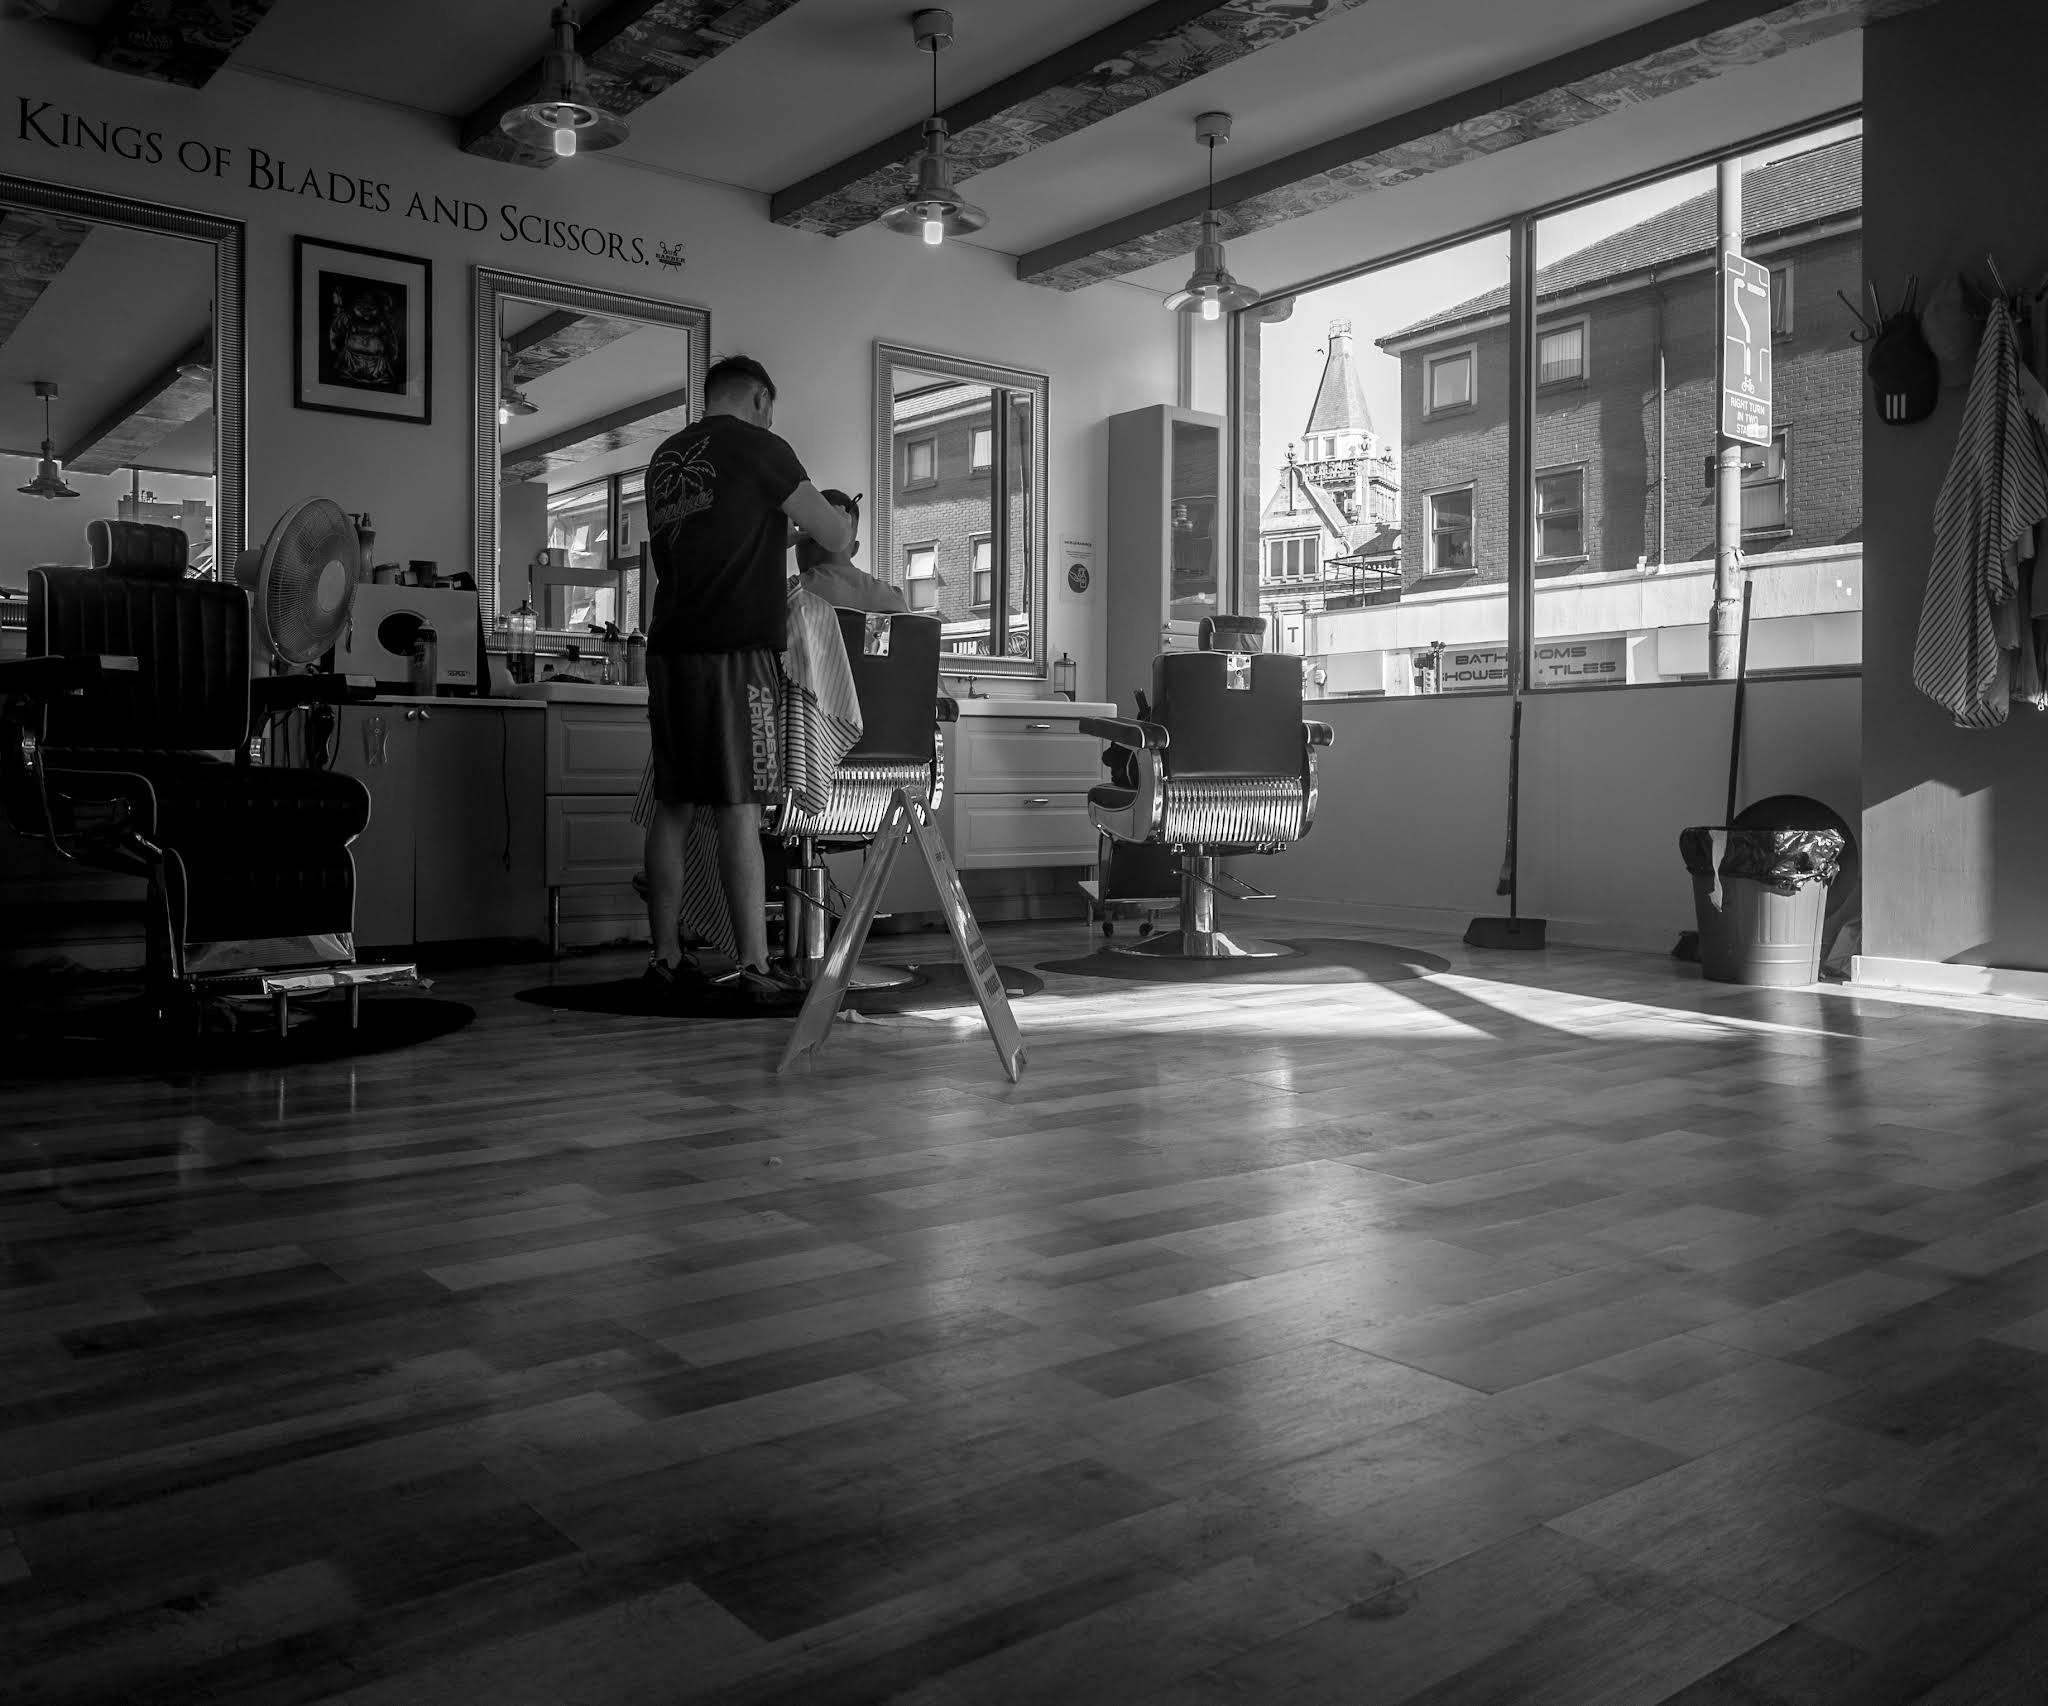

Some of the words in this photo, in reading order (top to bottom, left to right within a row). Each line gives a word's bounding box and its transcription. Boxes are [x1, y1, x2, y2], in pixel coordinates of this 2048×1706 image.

[18, 97, 163, 163] KINGS
[178, 141, 232, 178] OF
[248, 148, 391, 212] BLADES
[405, 192, 488, 232] AND
[1730, 397, 1748, 410] RIGHT
[1749, 402, 1765, 415] TURN
[1737, 411, 1744, 422] IN
[1745, 413, 1759, 425] TWO
[1456, 646, 1587, 666] BATHOMS
[1549, 662, 1616, 676] TILES
[746, 684, 768, 791] ARMOUR
[760, 687, 778, 769] UNDER
